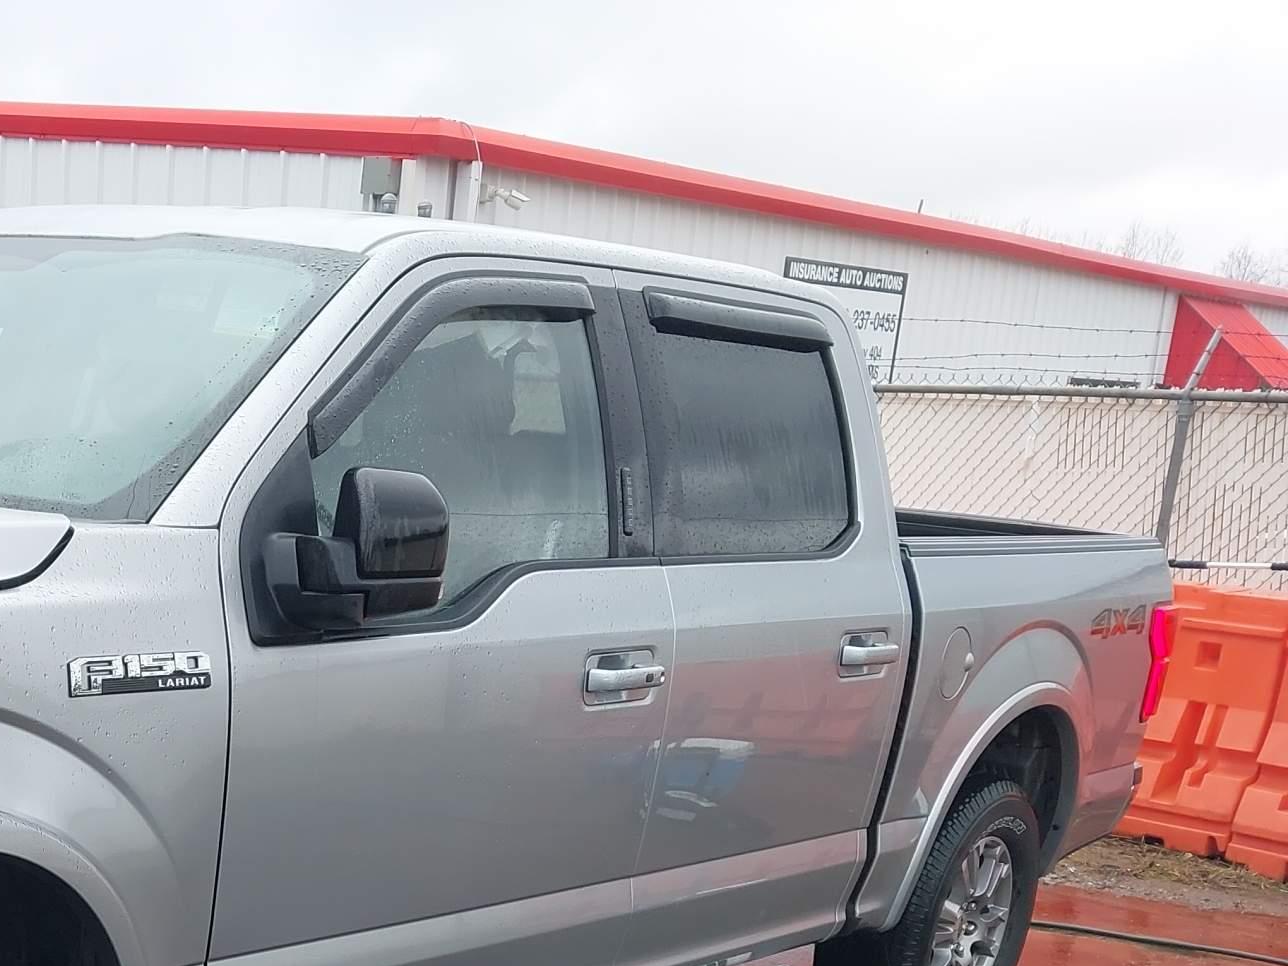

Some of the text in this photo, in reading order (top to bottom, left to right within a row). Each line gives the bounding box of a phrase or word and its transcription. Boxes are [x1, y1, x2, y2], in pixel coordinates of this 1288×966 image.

[789, 261, 904, 291] INSURANCE AUTO AUCTIONS
[158, 676, 207, 688] LARIAT
